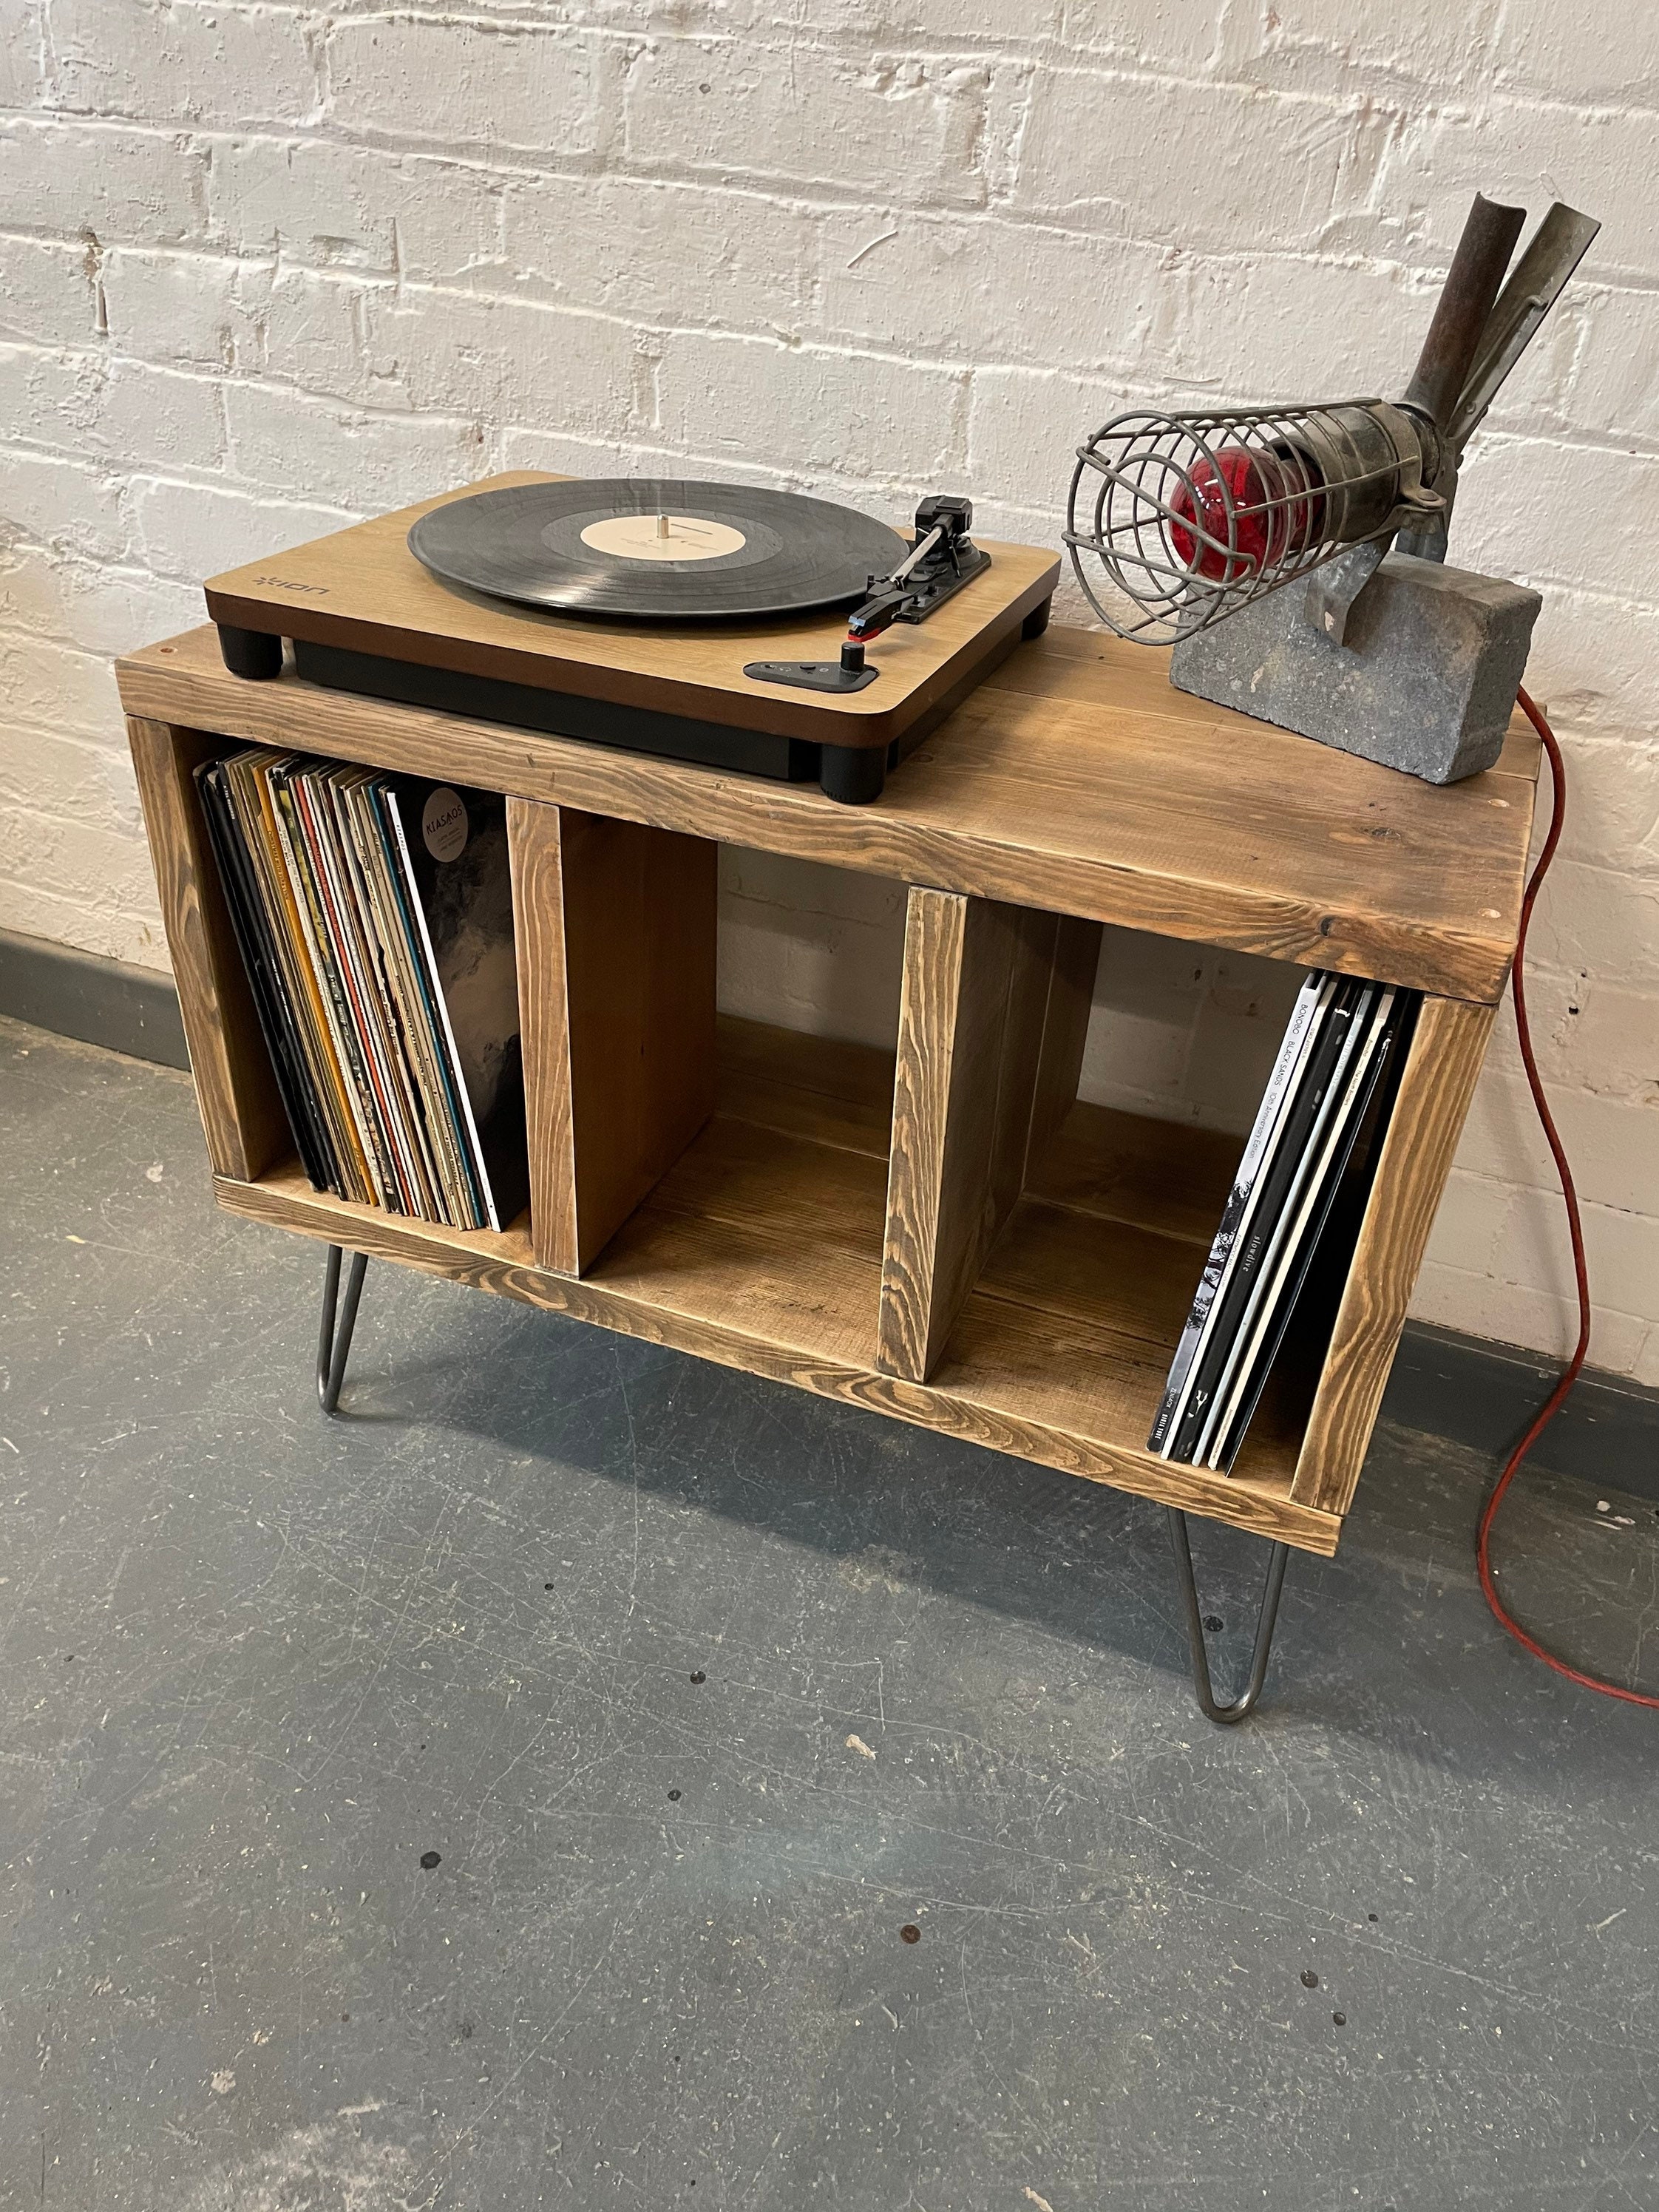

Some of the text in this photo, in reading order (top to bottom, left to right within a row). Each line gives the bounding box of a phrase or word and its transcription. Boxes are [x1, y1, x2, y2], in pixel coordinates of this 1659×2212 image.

[426, 804, 462, 835] KIASMOS
[396, 824, 405, 851] KIASMOS
[1363, 1039, 1373, 1057] Bonobo
[1249, 1003, 1307, 1158] BONOBO BLACK SANDS 10th Anniversary Edition
[1350, 1077, 1358, 1089] North
[1343, 1089, 1353, 1106] Borders
[1243, 1235, 1261, 1272] slowdive
